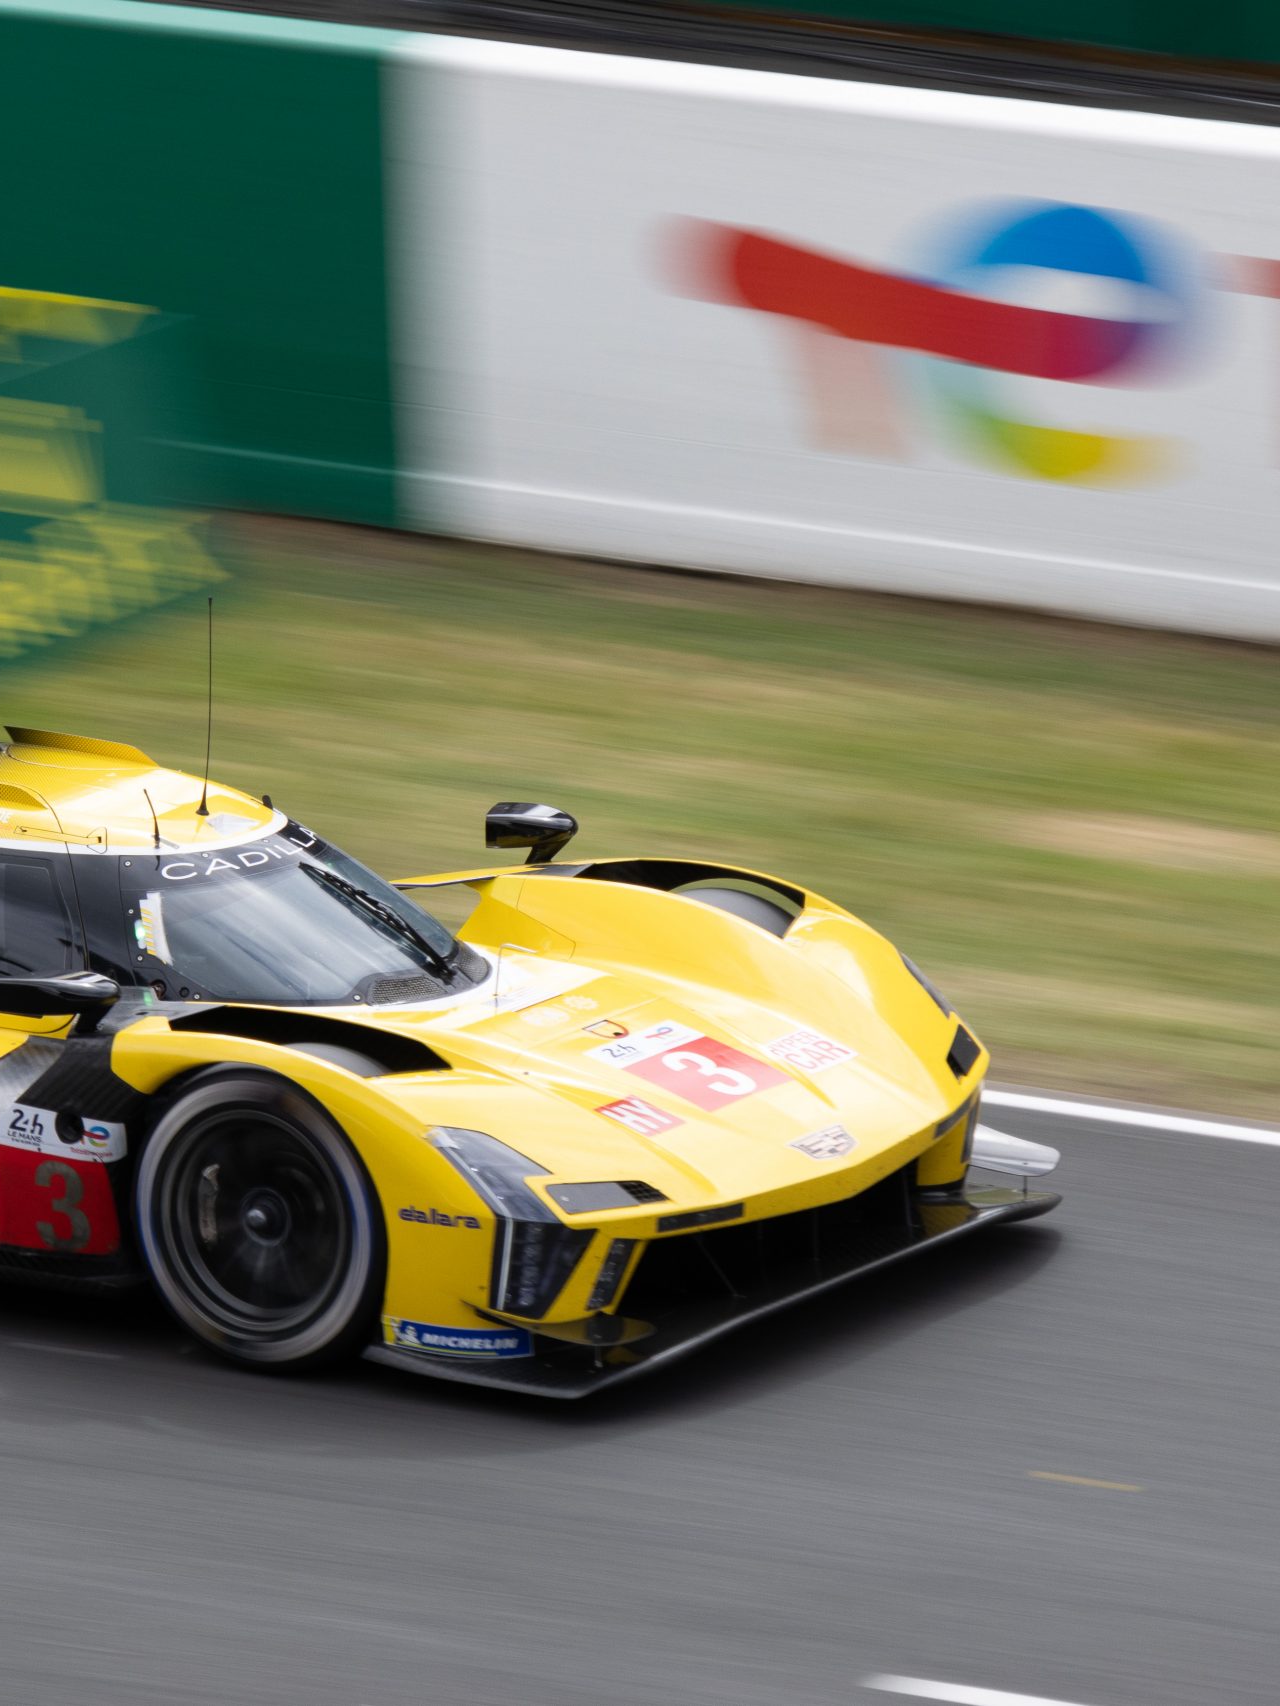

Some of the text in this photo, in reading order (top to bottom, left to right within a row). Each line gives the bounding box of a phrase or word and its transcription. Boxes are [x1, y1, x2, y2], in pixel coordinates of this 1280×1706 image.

[161, 827, 317, 880] CADILLA
[661, 1051, 757, 1096] 3
[784, 1040, 850, 1070] CAR
[600, 1099, 673, 1134] HY
[34, 1160, 91, 1249] 3
[422, 1332, 519, 1350] MICHELIN
